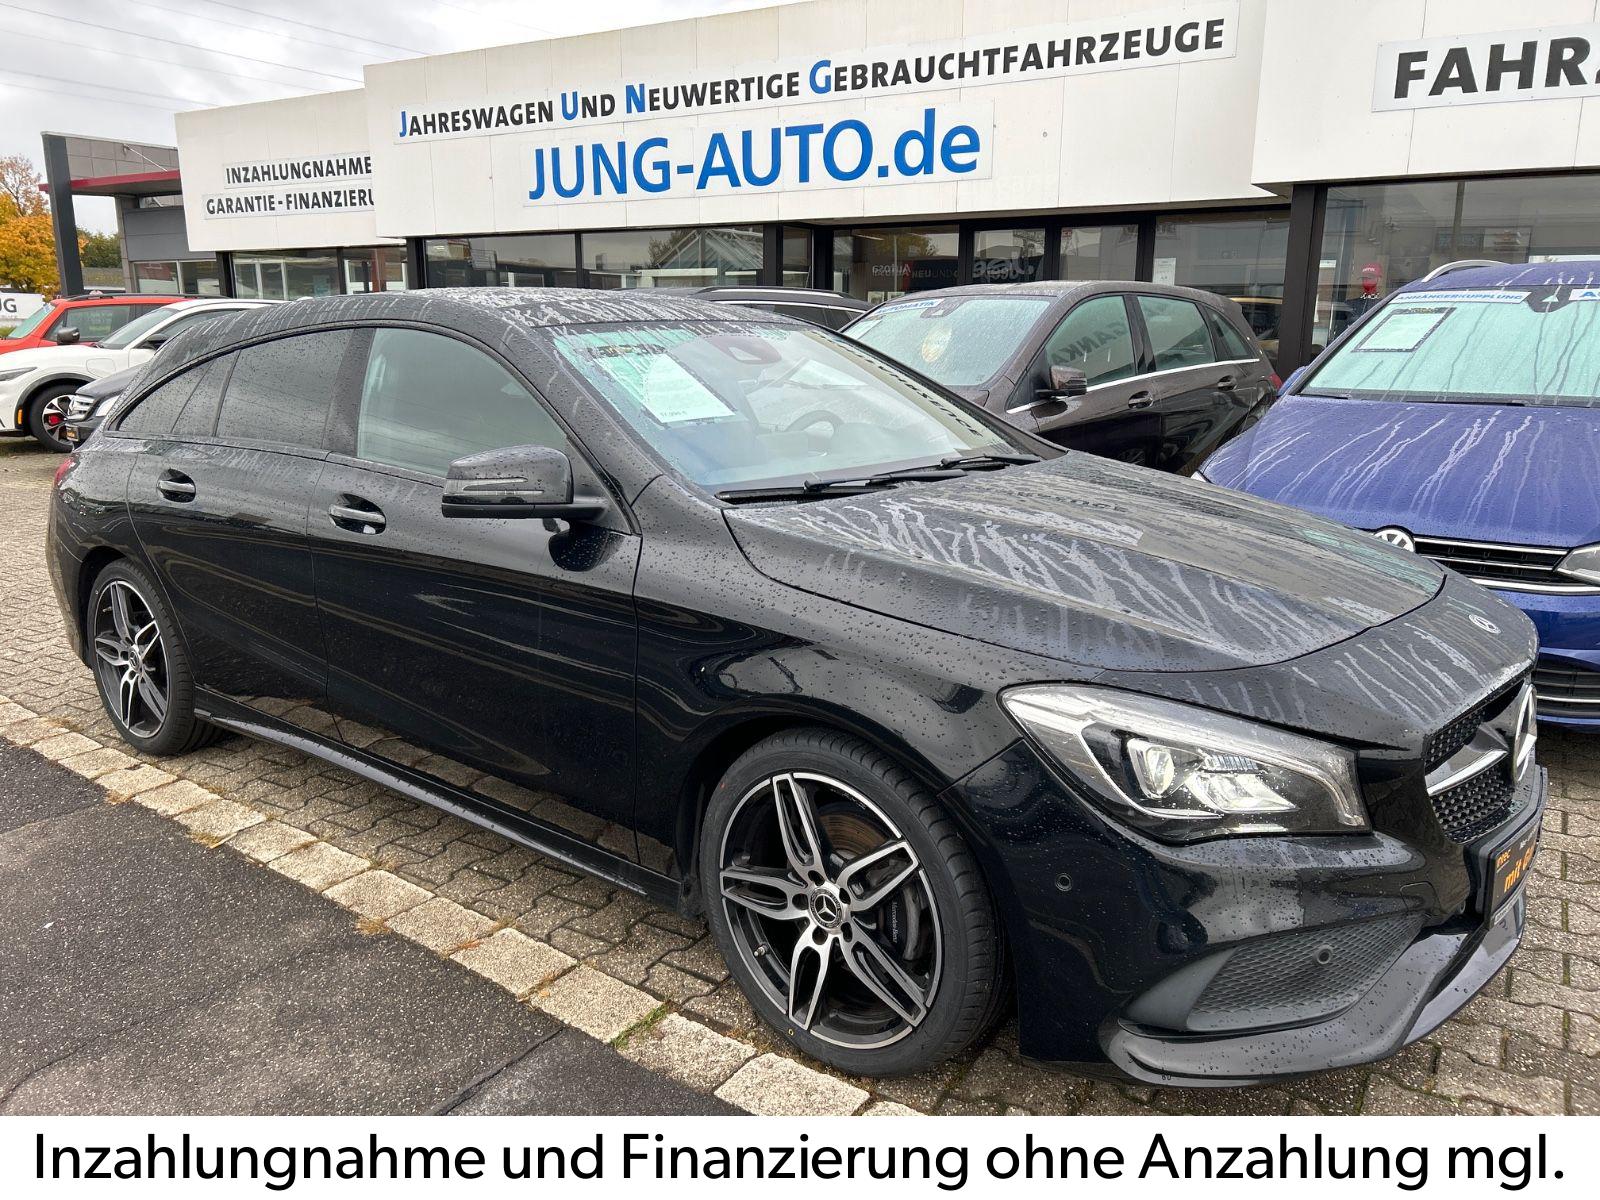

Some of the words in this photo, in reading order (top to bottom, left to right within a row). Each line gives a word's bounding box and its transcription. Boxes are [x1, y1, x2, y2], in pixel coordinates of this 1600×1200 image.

[399, 101, 554, 138] JAHRESWAGEN
[561, 91, 616, 121] UND
[625, 71, 800, 114] NEUWERTIGE
[809, 18, 1225, 95] GEBRAUCHTFAHRZEUGE
[1394, 36, 1600, 99] FAHR
[529, 108, 980, 200] JUNG-AUTO.de
[226, 156, 372, 184] INZAHLUNGNAHME
[0, 298, 17, 313] G
[875, 301, 934, 314] AUTOMATIK
[1397, 293, 1523, 301] ANHÄNGERKUPPLUNG
